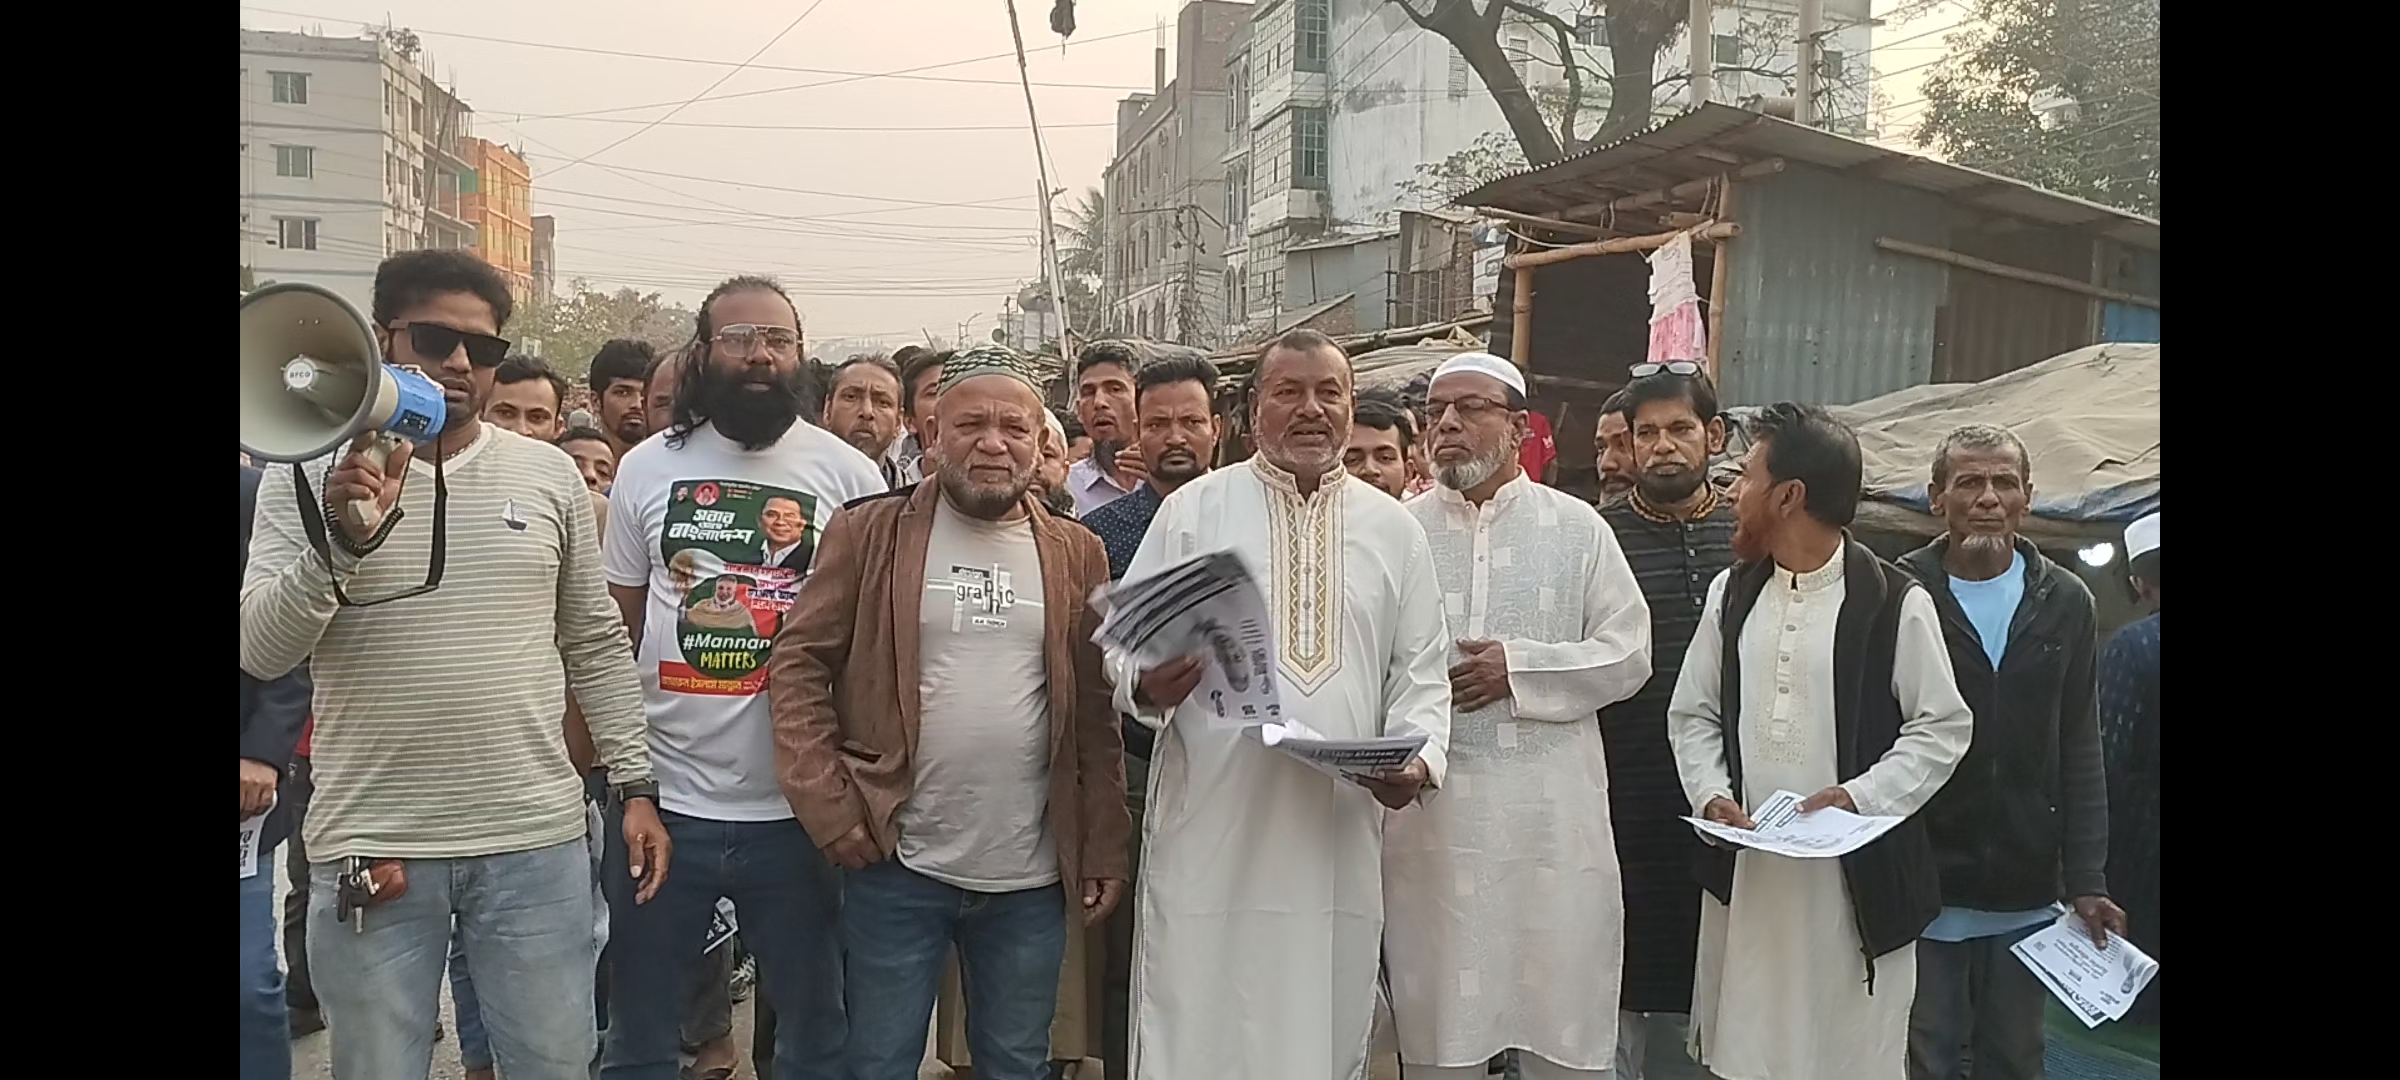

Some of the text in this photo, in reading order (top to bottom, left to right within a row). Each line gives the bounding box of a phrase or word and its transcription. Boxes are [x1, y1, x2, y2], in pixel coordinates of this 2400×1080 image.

[692, 508, 736, 529] সবার
[668, 522, 756, 545] বাংলাদেশ
[682, 633, 772, 650] #Mannan
[700, 651, 757, 669] MATTERS
